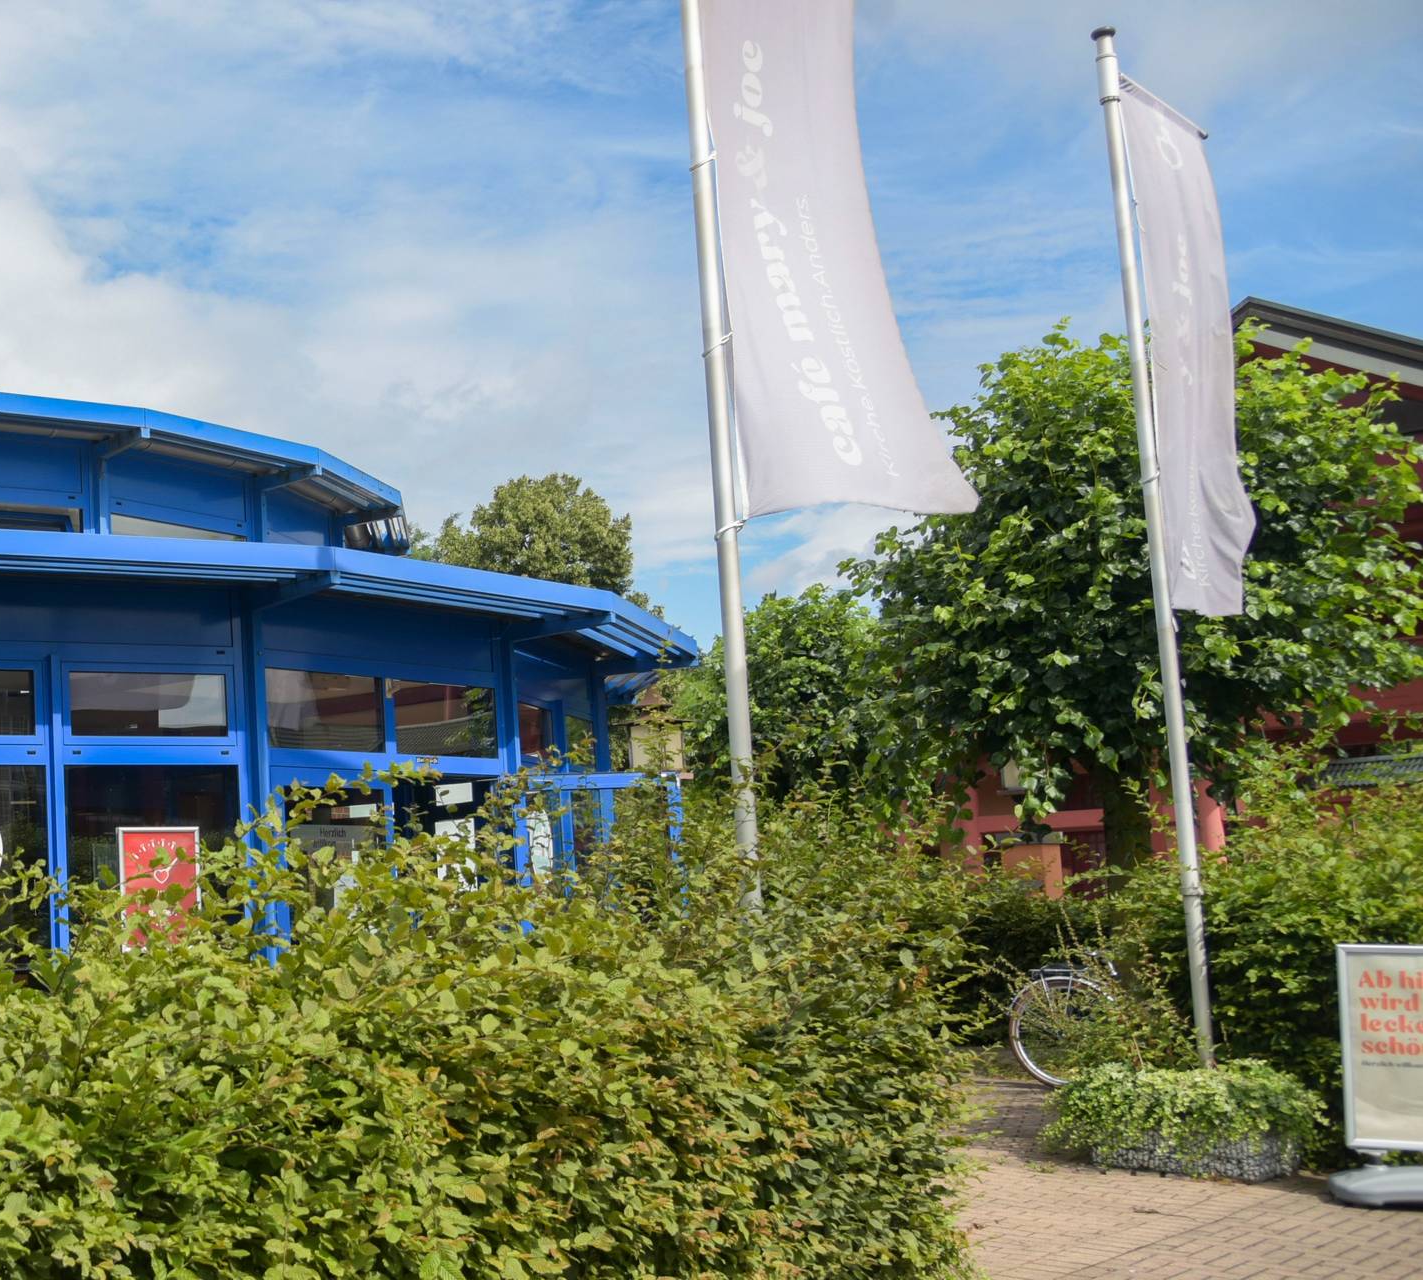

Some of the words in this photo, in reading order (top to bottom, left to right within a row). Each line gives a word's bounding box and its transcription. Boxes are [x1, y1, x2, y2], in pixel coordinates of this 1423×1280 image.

[733, 39, 773, 137] joe
[735, 145, 769, 190] &
[745, 197, 817, 343] mary
[1171, 231, 1193, 307] joe
[790, 354, 864, 467] café
[1359, 969, 1394, 989] Ab
[1359, 991, 1420, 1012] wird
[1360, 1013, 1423, 1034] lecke
[1360, 1035, 1423, 1056] schö
